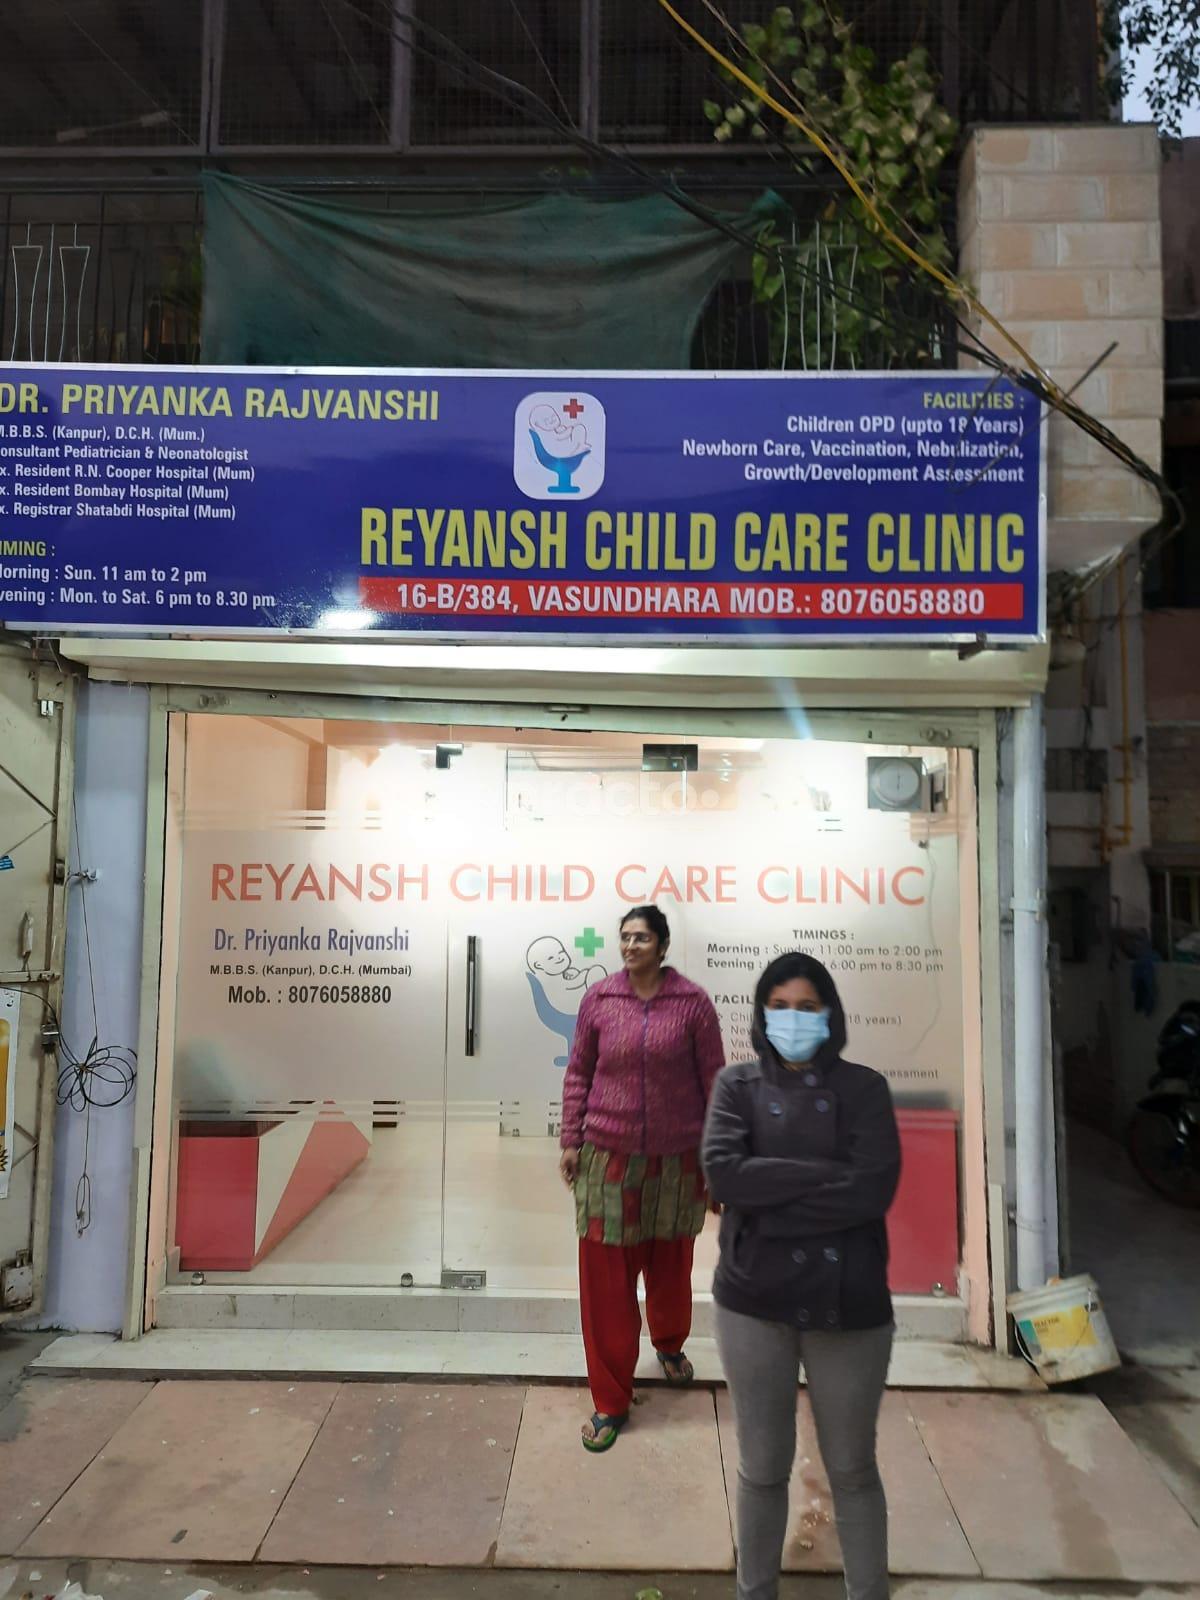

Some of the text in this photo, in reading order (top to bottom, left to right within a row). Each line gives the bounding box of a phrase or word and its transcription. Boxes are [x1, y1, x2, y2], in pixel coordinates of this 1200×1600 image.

[0, 383, 439, 421] DR. PRIYANKA RAJVANSHI
[52, 425, 110, 441] (Kanpur),
[115, 426, 154, 440] D.C.H.
[159, 427, 205, 443] (Mum.)
[787, 416, 1024, 437] Children OPD (upto 18 Years)
[0, 445, 249, 463] onsultant Pediatrician & Neonatologist
[683, 439, 758, 456] Newborn
[763, 439, 805, 458] Care,
[811, 440, 911, 459] Vaccination,
[15, 463, 71, 477] Resident
[75, 464, 101, 478] R.N.
[106, 465, 152, 481] Cooper
[156, 465, 208, 481] Hospital
[213, 466, 255, 482] (Mum)
[745, 463, 918, 485] Growth/Development
[14, 483, 70, 496] Resident
[74, 484, 125, 500] Bombay
[130, 484, 182, 500] Hospital
[187, 485, 229, 501] (Mum)
[13, 502, 72, 518] Registrar
[76, 502, 133, 517] Shatabdi
[136, 503, 189, 520] Hospital
[194, 504, 236, 520] (Mum)
[0, 541, 46, 556] IMING
[361, 507, 1024, 573] REYANSH CHILD CARE CLINIC
[64, 564, 97, 580] Sun.
[102, 565, 118, 581] 11
[124, 569, 147, 582] am
[151, 568, 166, 582] to
[170, 566, 180, 582] 2
[184, 570, 207, 586] pm
[0, 587, 46, 606] vening
[60, 587, 98, 604] Mon.
[102, 590, 117, 604] to
[122, 588, 150, 605] Sat.
[155, 590, 164, 605] 6
[169, 593, 192, 609] pm
[196, 592, 211, 606] to
[216, 590, 248, 607] 8.30
[252, 594, 276, 611] pm
[397, 583, 518, 614] 16-B/384,
[528, 585, 721, 614] VASUNDHARA
[821, 588, 985, 615] 8076058880
[211, 863, 925, 906] REYANSH CHILD CARE CLINIC
[214, 926, 409, 957] Dr. Priyanka Rajvanshi
[792, 930, 847, 940] TIMINGS
[707, 943, 760, 956] Morning
[856, 948, 876, 956] am
[878, 946, 890, 956] to
[893, 946, 921, 957] 2:00
[924, 949, 943, 958] pm
[210, 965, 412, 978] M.B.B.S. (Kanpur), D.C.H. (Mumbai)
[707, 957, 755, 970] Evening
[859, 963, 877, 973] pm
[881, 961, 892, 971] to
[925, 963, 944, 974] pm
[228, 985, 272, 1004] Mob.
[288, 985, 392, 1004] 8076058880
[865, 1014, 902, 1027] years)
